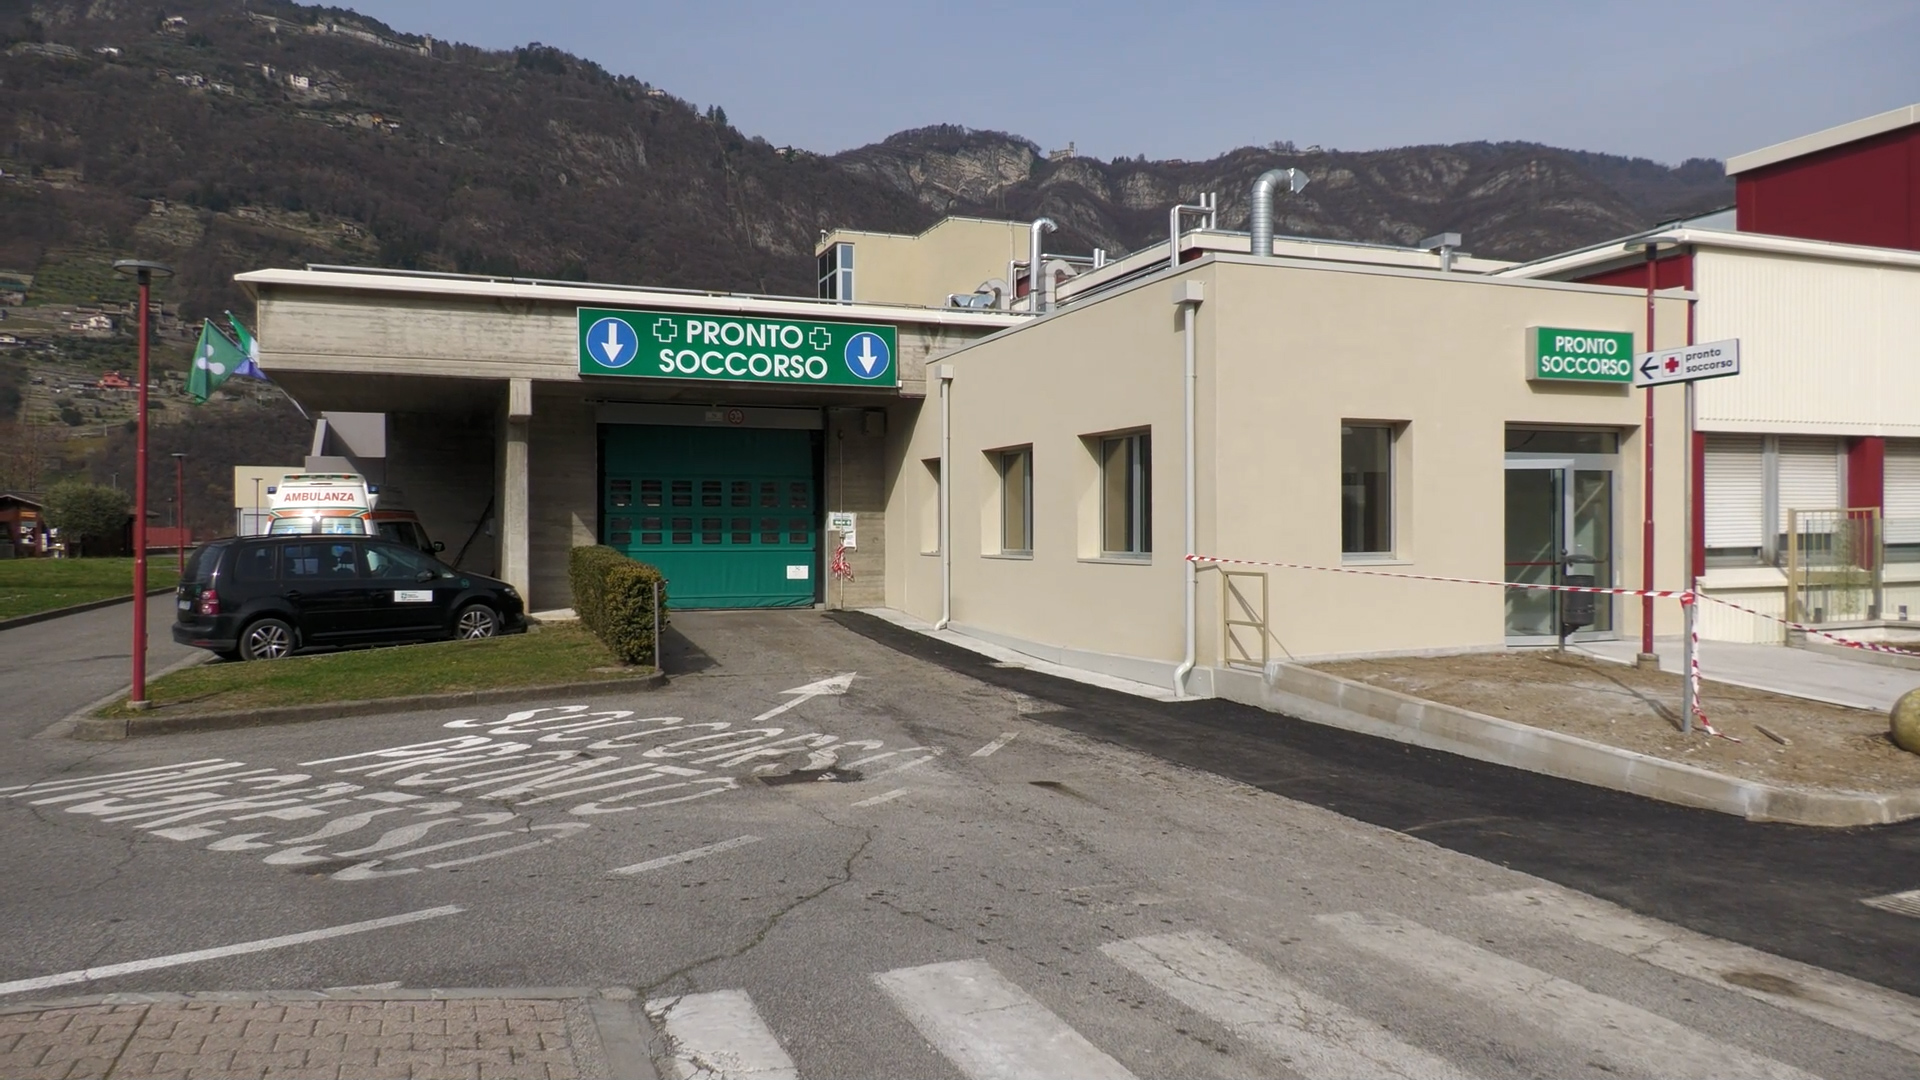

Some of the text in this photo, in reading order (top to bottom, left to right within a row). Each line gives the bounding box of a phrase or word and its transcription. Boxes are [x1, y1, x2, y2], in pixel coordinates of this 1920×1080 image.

[686, 320, 804, 349] PRONTO
[1555, 335, 1617, 355] PRONTO
[658, 349, 828, 379] SOCCORSO
[1541, 355, 1631, 376] SOCCORSO
[1685, 348, 1722, 362] pronto
[1685, 359, 1734, 374] soccorso
[284, 492, 355, 502] AMBULANZA
[298, 735, 740, 814] PRONTO
[0, 759, 591, 882] INGRESSO
